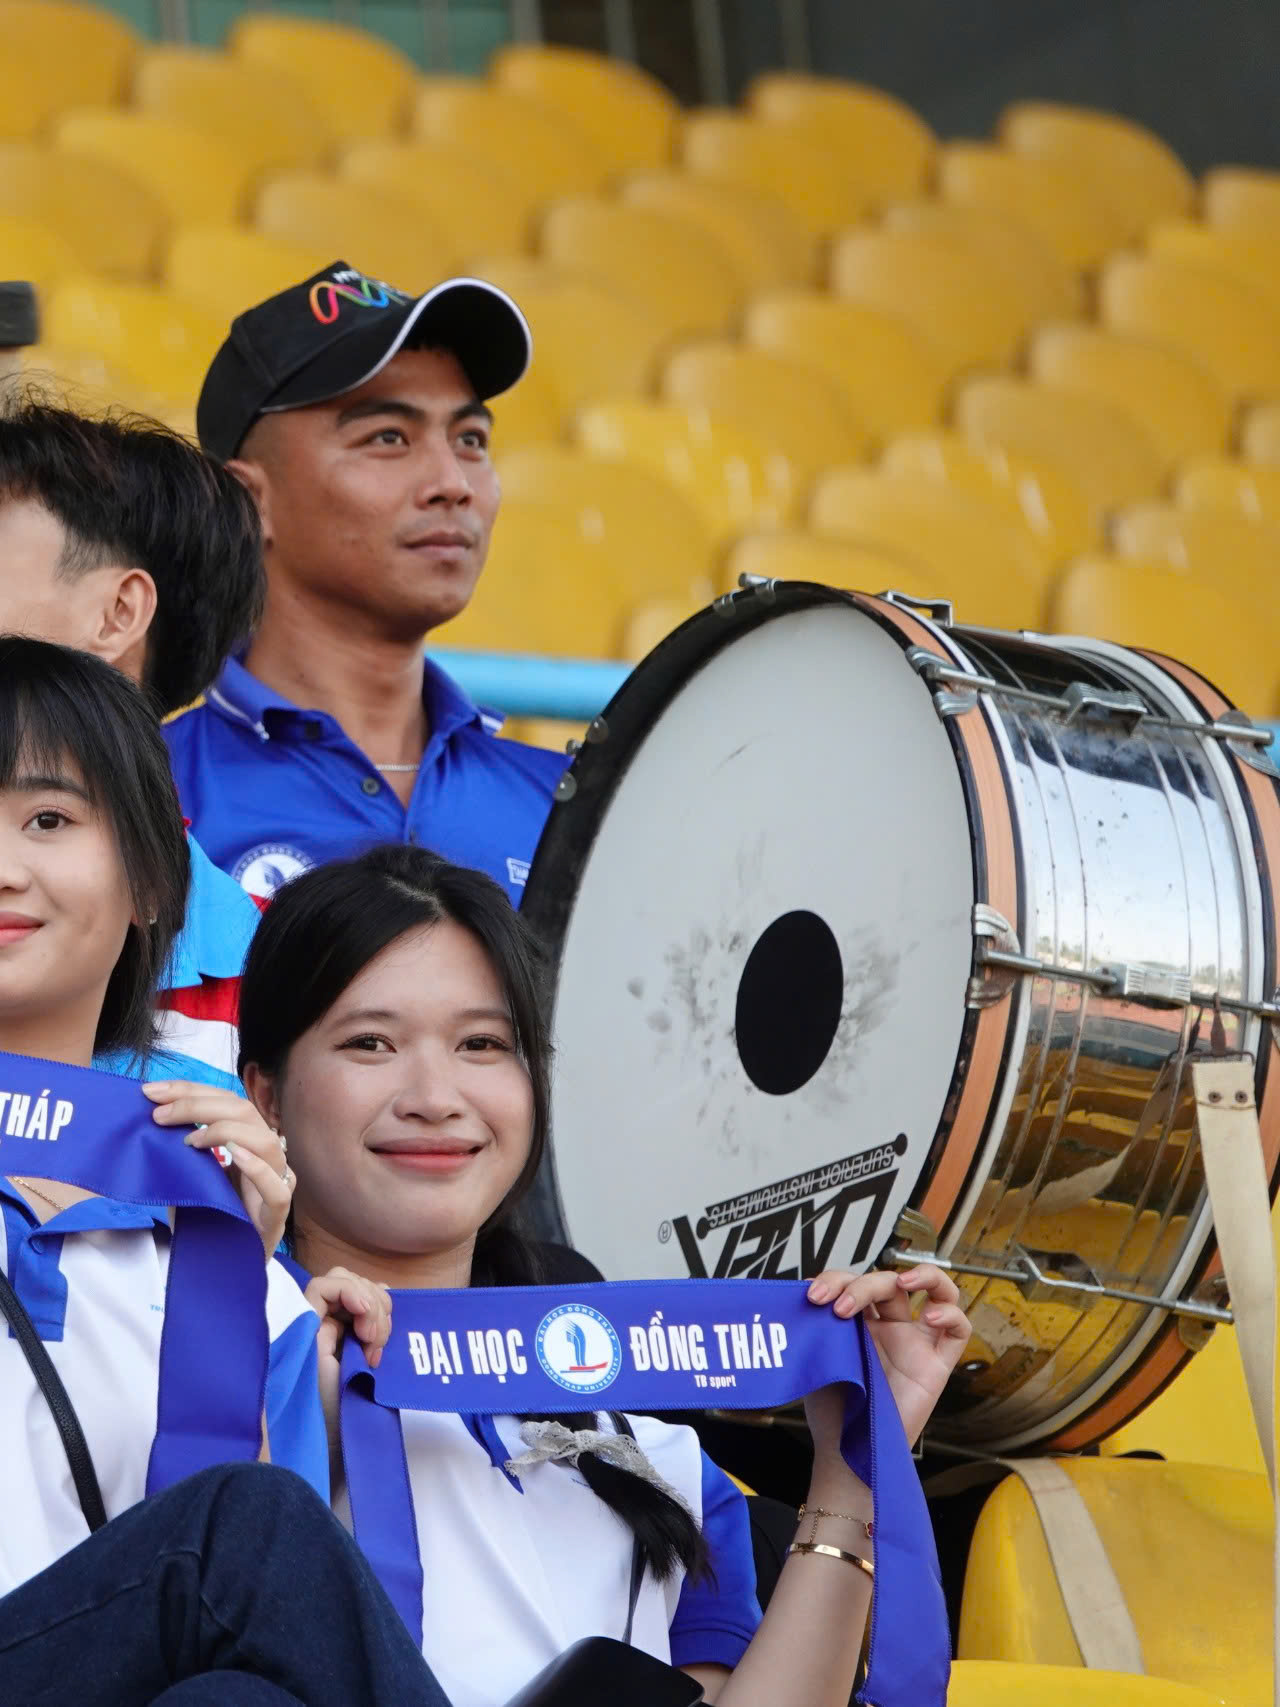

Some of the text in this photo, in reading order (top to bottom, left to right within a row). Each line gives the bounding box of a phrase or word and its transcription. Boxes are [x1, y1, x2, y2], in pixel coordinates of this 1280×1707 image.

[708, 1145, 898, 1229] SUPERIOR INSTRUMENTS
[407, 1311, 788, 1384] ĐẠI HỌC ĐỒNG THÁP
[694, 1374, 737, 1389] TB sport
